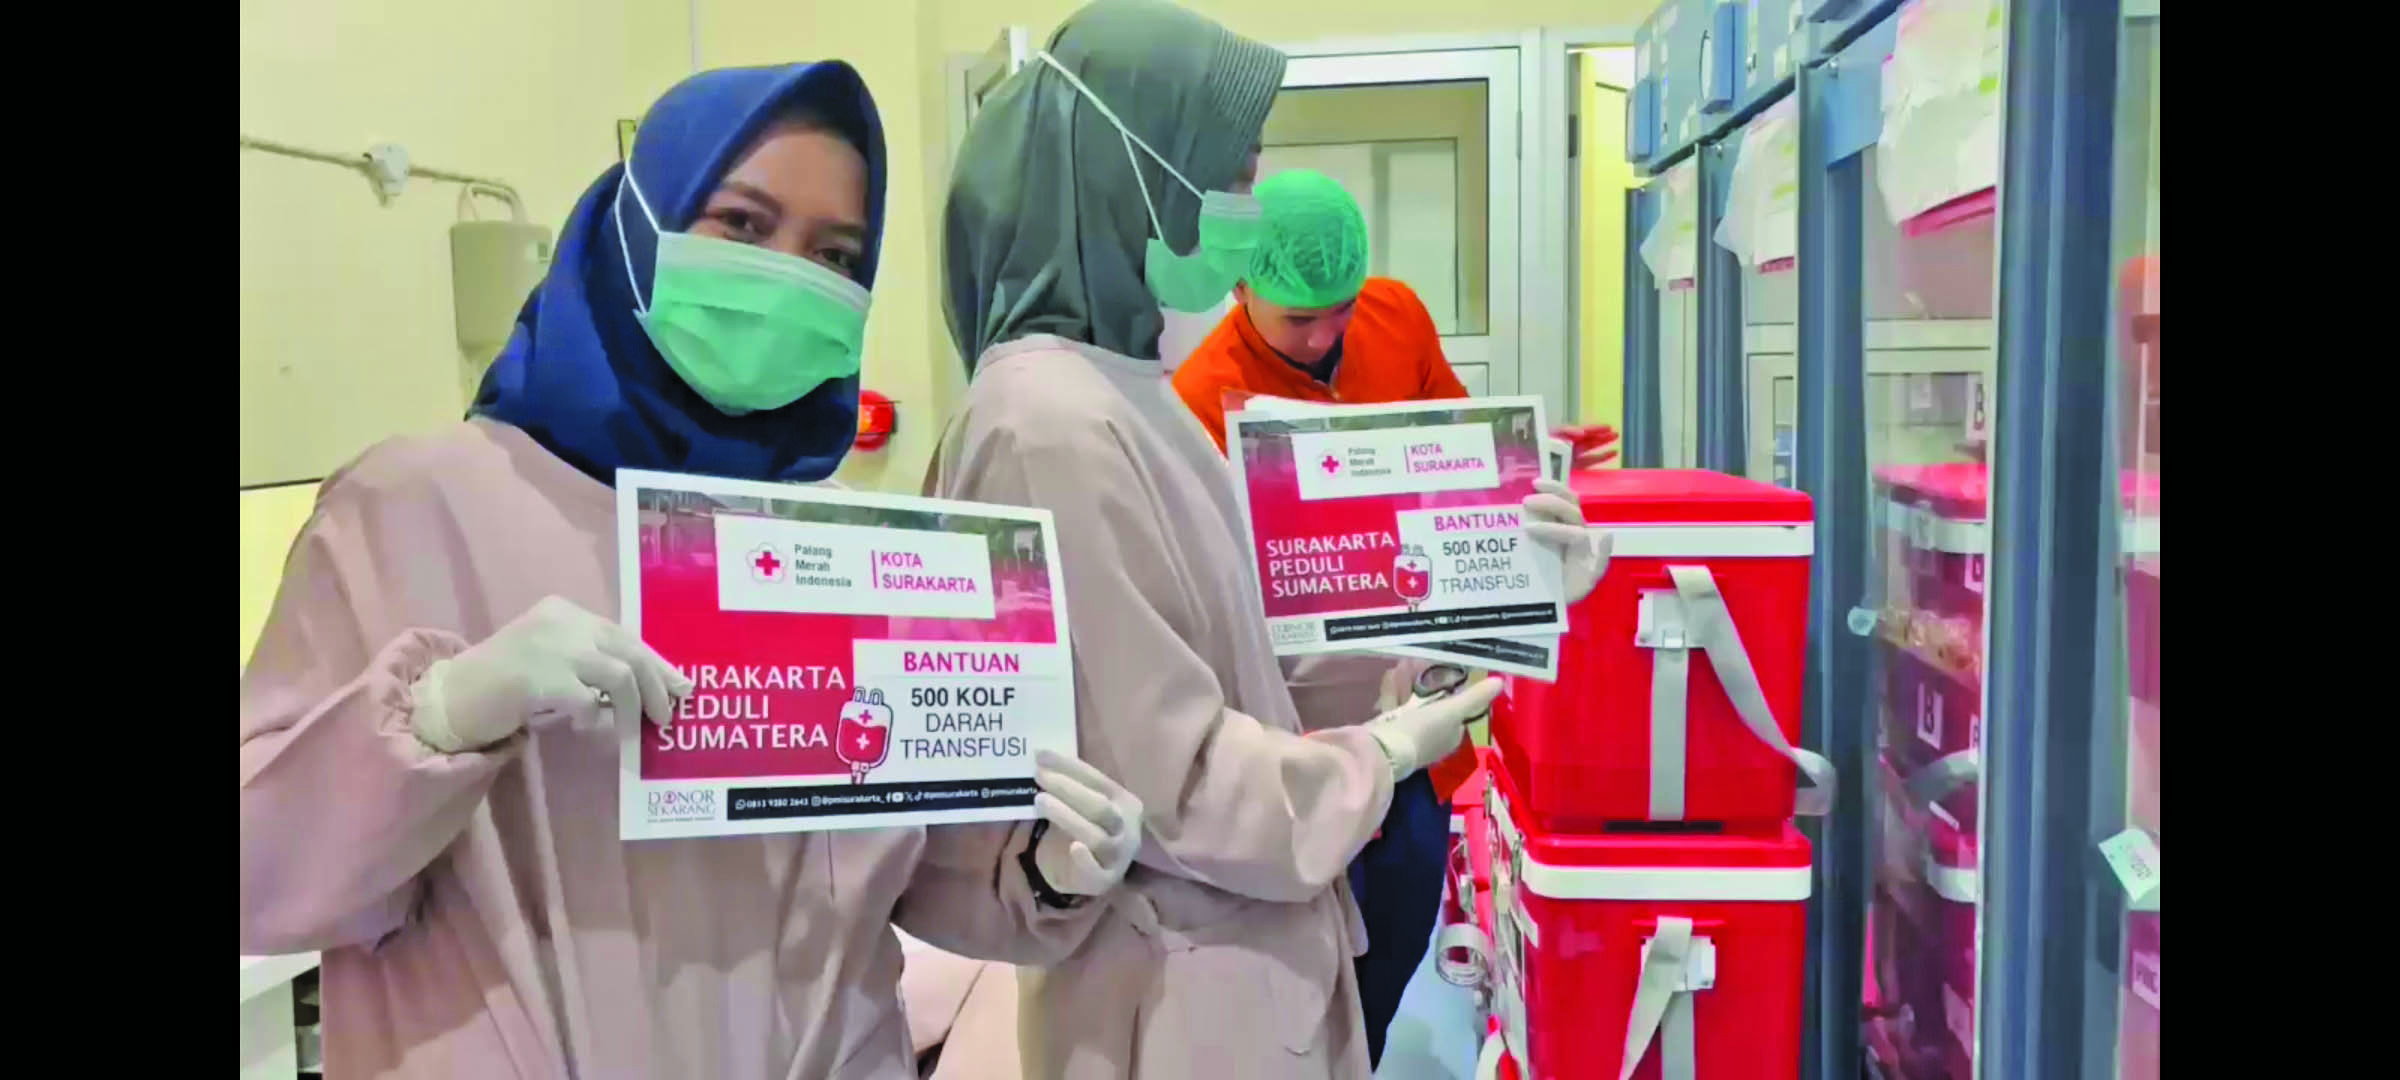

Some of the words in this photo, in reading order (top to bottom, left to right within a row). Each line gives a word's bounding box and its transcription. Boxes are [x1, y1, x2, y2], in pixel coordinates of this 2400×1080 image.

[1411, 444, 1442, 456] KOTA
[1413, 457, 1485, 473] SURAKARTA
[1434, 512, 1519, 531] BANTUAN
[794, 543, 833, 559] Palang
[1266, 531, 1396, 557] SURAKARTA
[1442, 541, 1471, 556] 500
[1475, 538, 1518, 553] KOLF
[795, 559, 831, 572] Merah
[880, 552, 924, 569] KOTA
[1269, 555, 1344, 577] PEDULI
[1455, 556, 1512, 574] DARAH
[796, 575, 853, 588] Indonesia
[883, 573, 977, 593] SURAKARTA
[1271, 571, 1390, 598] SUMATERA
[1440, 574, 1530, 593] TRANSFUSI
[903, 651, 1020, 673] BANTUAN
[679, 665, 847, 690] URAKARTA
[911, 687, 949, 707] 500
[956, 687, 1016, 707] KOLF
[670, 695, 770, 721] EDULI
[926, 712, 1003, 733] DARAH
[658, 724, 830, 751] SUMATERA
[900, 736, 1027, 759] TRANSFUSI
[648, 789, 716, 805] DONOR
